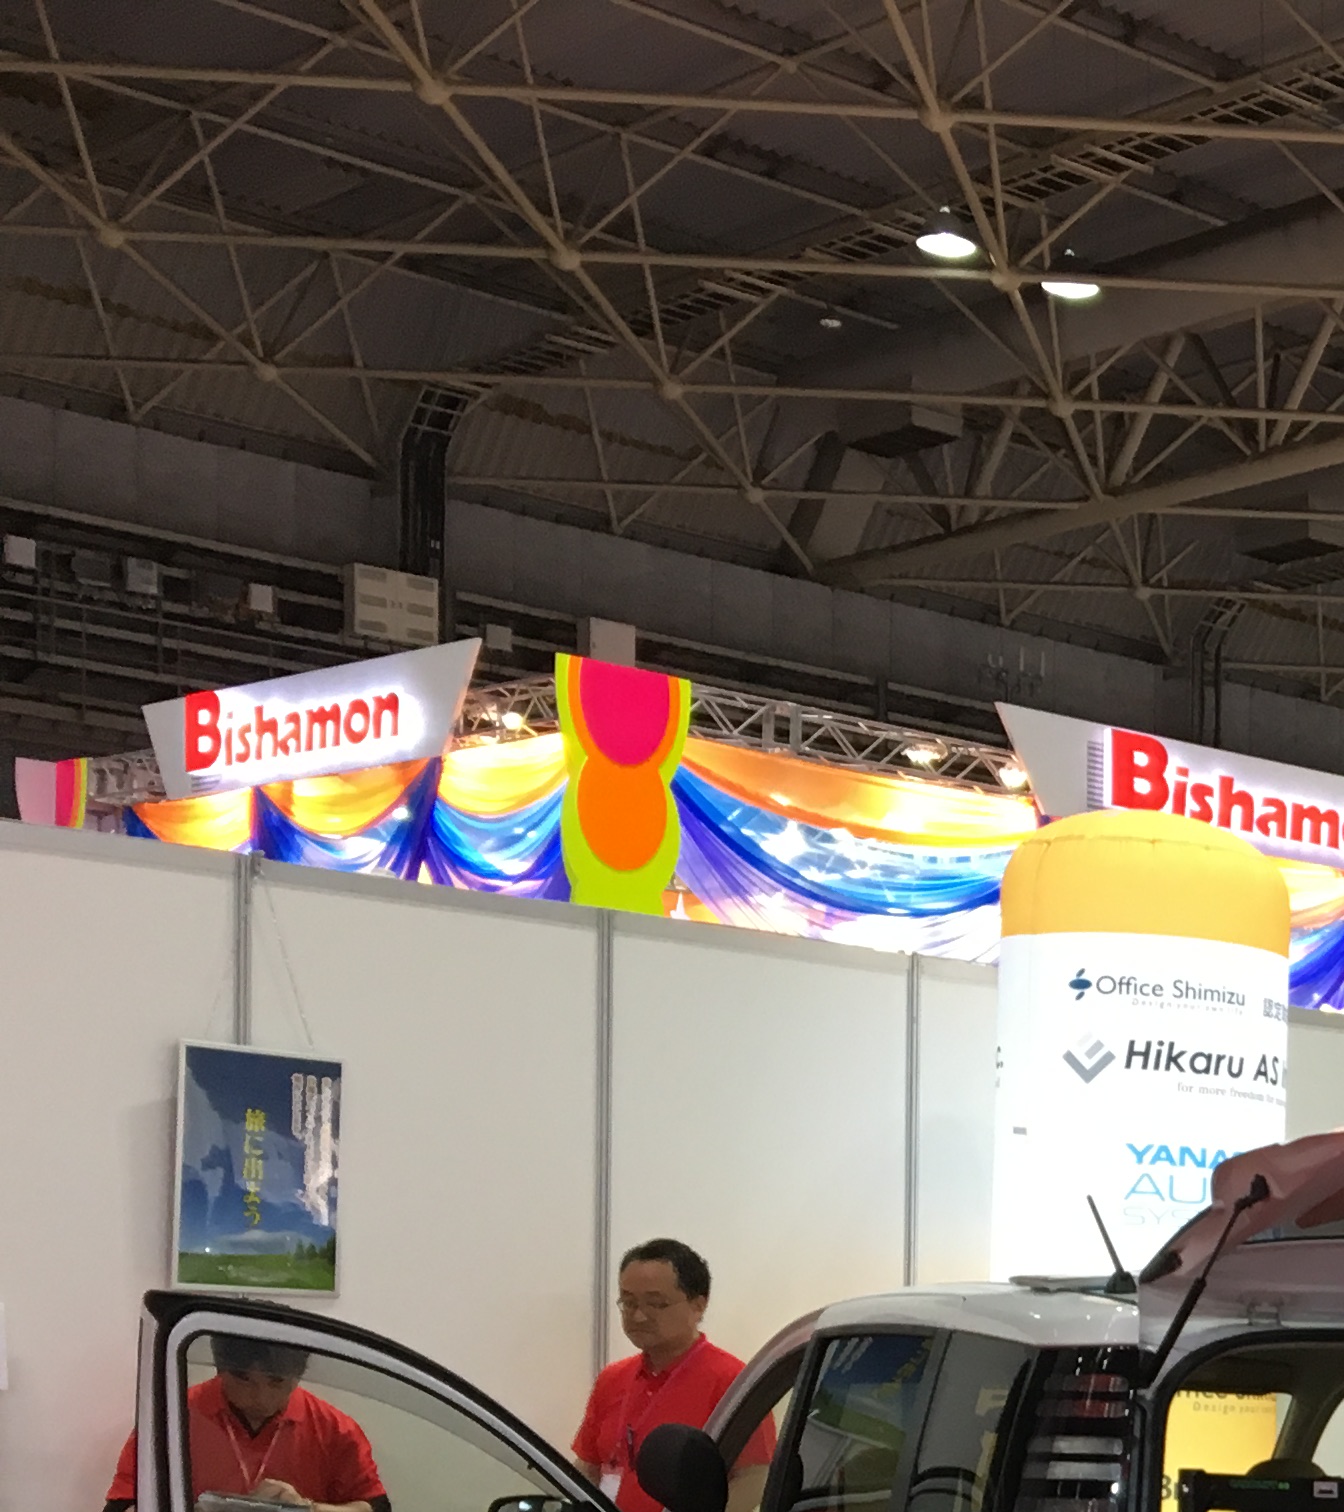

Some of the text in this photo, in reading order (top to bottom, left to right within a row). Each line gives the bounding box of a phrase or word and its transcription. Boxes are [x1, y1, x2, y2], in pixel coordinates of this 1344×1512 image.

[184, 690, 400, 772] Bishamon
[1096, 975, 1246, 1007] Office Shimizu
[1124, 1040, 1245, 1079] Hikaru
